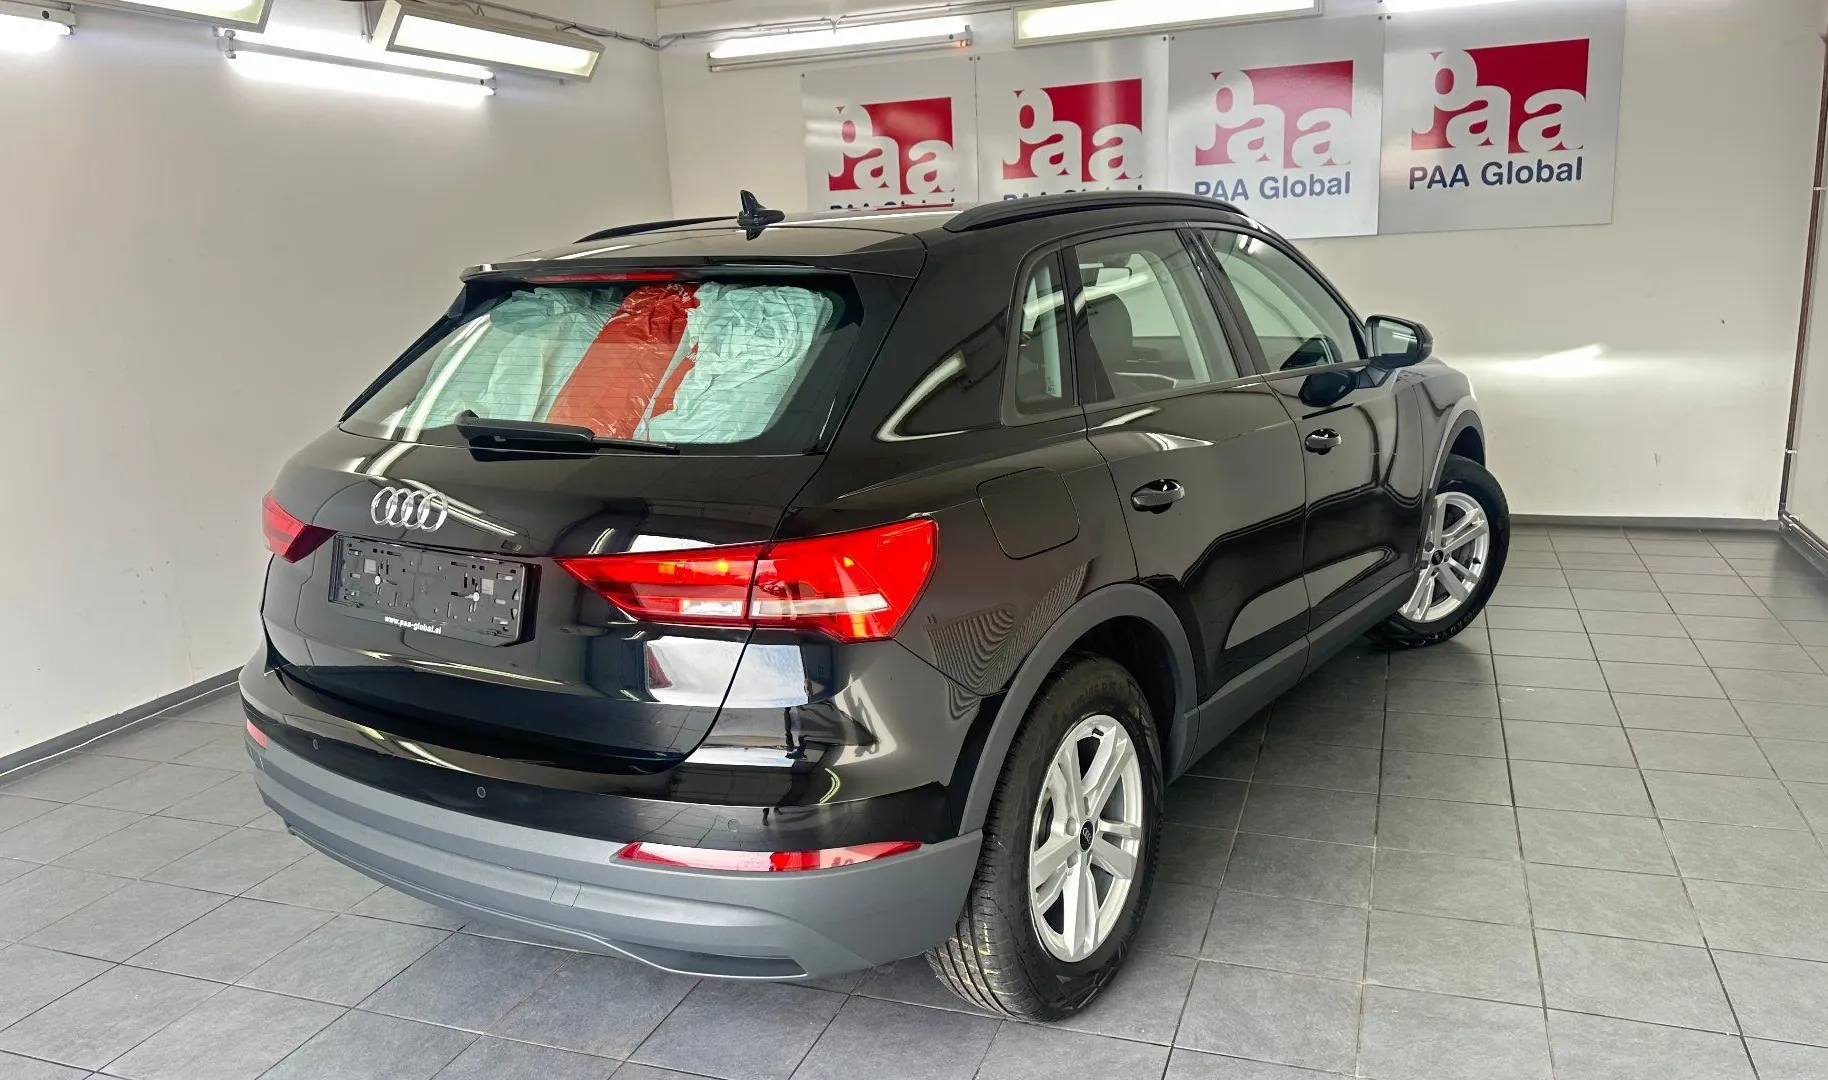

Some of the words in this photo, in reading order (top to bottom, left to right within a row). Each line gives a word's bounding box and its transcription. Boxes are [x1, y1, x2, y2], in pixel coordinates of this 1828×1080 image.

[1194, 178, 1250, 202] PAA
[1259, 171, 1351, 200] Global
[1409, 163, 1470, 190] PAA
[1481, 156, 1583, 186] Global
